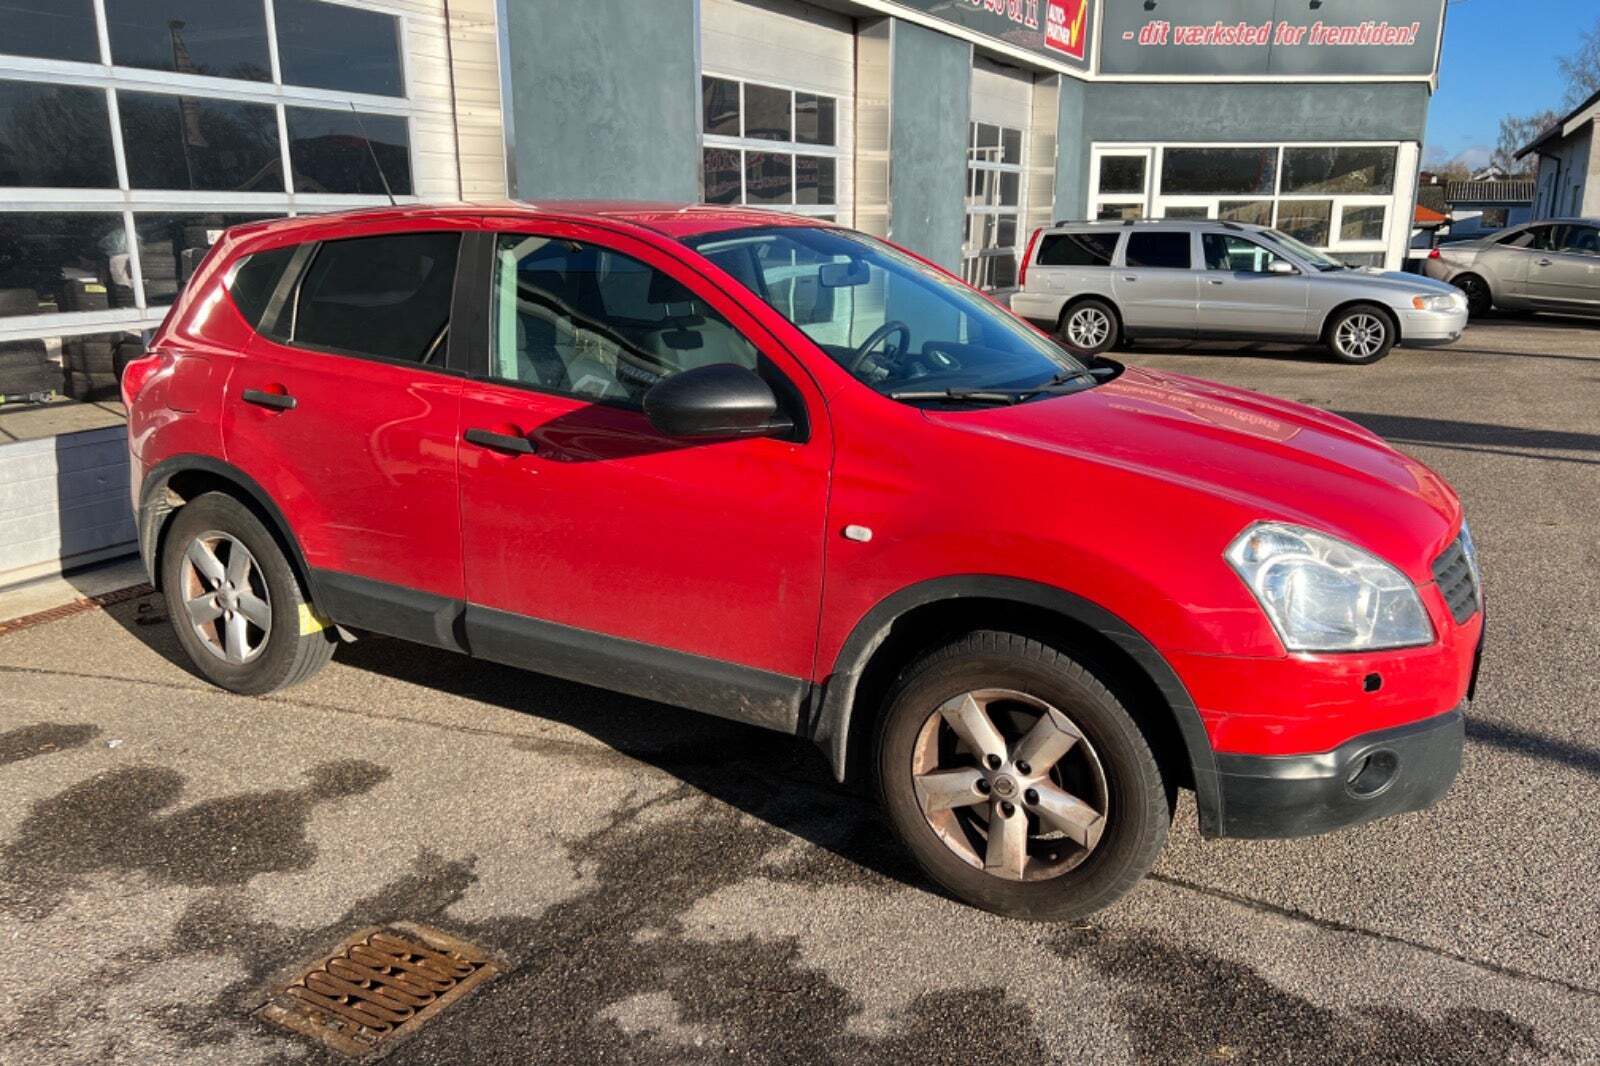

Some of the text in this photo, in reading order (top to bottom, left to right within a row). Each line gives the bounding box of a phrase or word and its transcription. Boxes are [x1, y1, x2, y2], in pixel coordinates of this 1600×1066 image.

[1139, 20, 1169, 45] dit
[1174, 21, 1272, 45] værksted
[1274, 20, 1307, 45] for
[1308, 20, 1420, 46] fremtiden!
